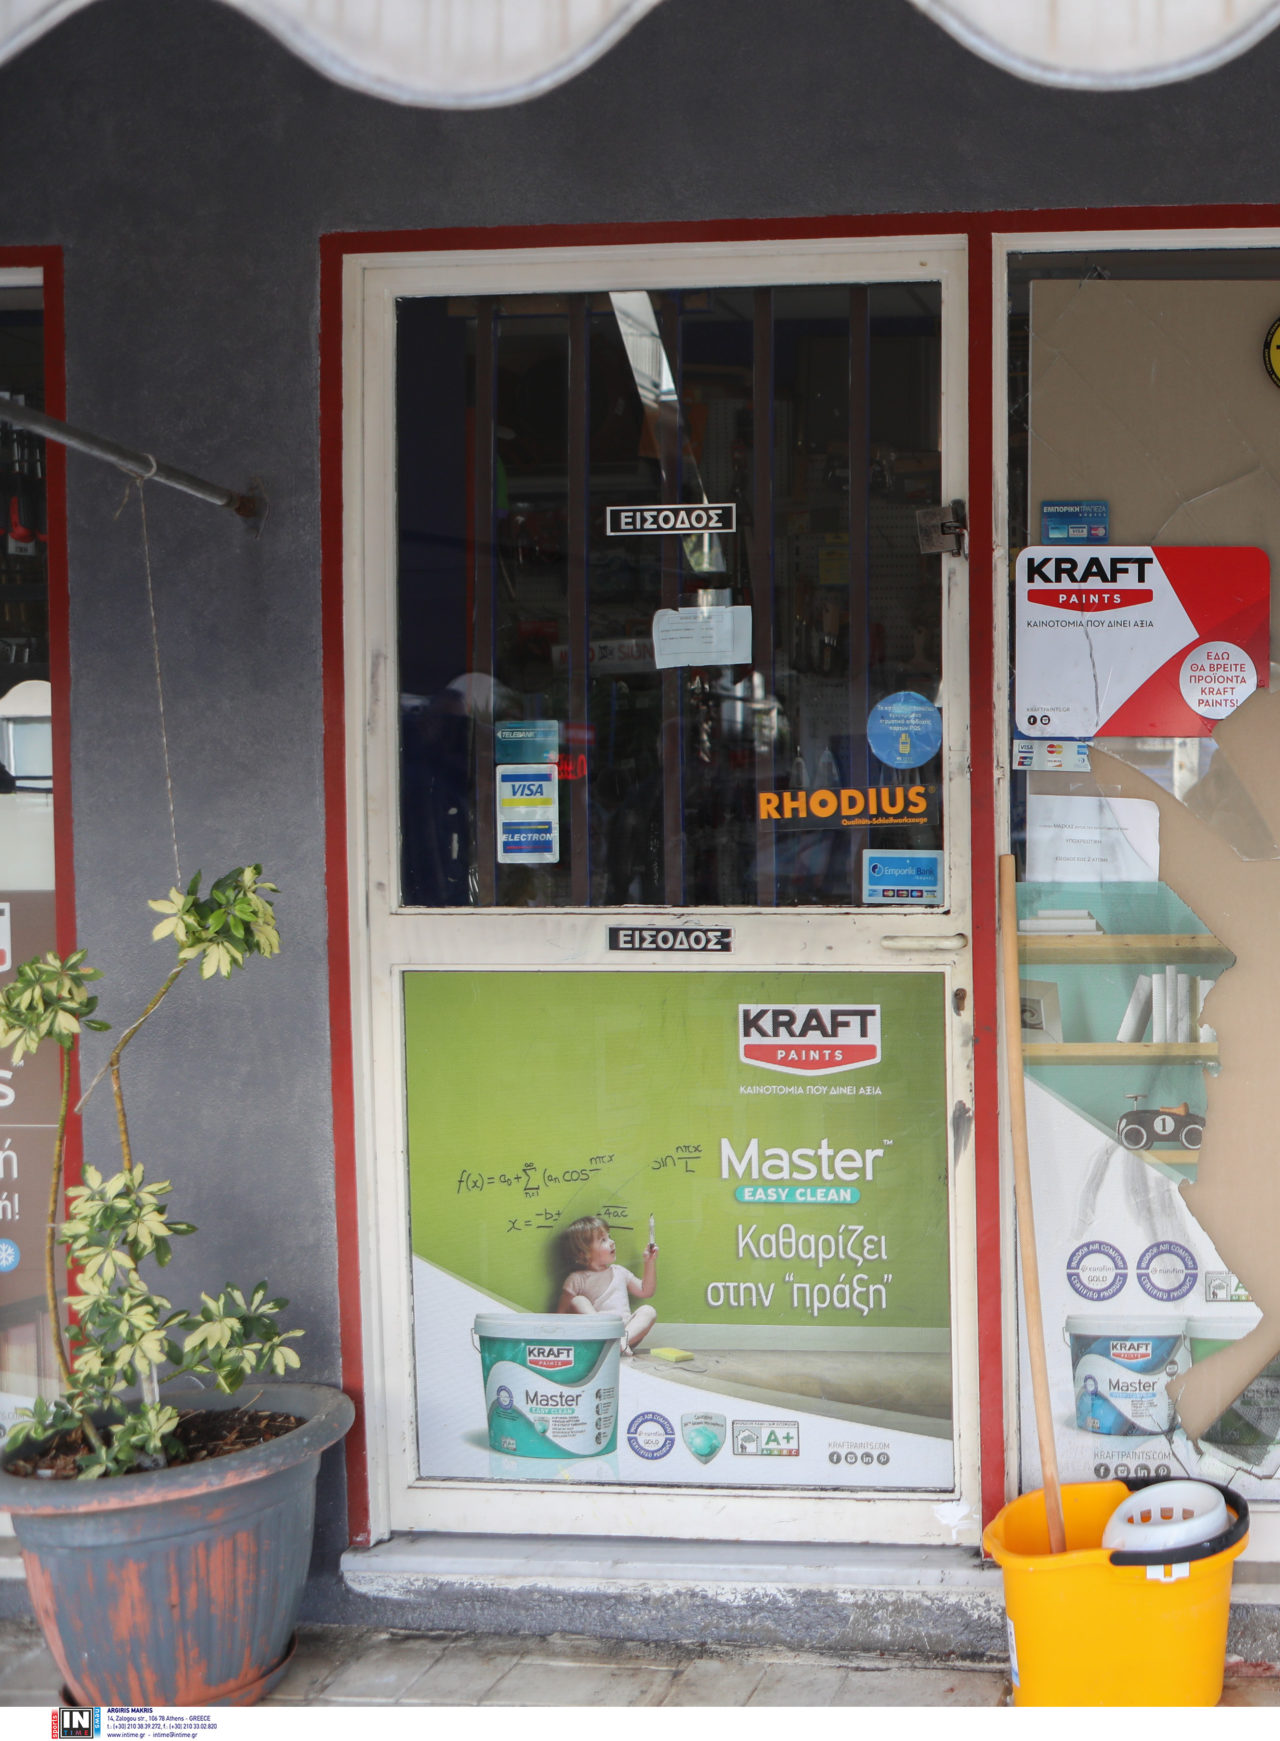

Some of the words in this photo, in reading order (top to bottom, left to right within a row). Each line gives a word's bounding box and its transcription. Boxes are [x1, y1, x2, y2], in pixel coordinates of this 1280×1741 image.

[620, 509, 723, 530] ΕΙΣΟΔΟΣ
[1027, 557, 1154, 584] KRAFT
[1059, 593, 1122, 604] PAINTS
[1027, 620, 1084, 628] ΚΑΙΝΟΤΟΜΙΑ
[1086, 620, 1106, 628] ΠΟΥ
[1107, 620, 1132, 628] ΔΙΝΕΙ
[1133, 620, 1154, 628] ΑΞΙΑ
[1206, 651, 1230, 661] ΕΔΩ
[1189, 662, 1206, 672] ΘΑ
[1208, 662, 1247, 672] ΒΡΕΙΤΕ
[1189, 673, 1247, 684] ΠΡΟΪΟΝΤΑ
[1200, 686, 1236, 696] KRAFT
[1197, 698, 1240, 708] PAINTS!
[511, 783, 545, 797] VISA
[759, 785, 928, 820] RHODIUS
[502, 833, 554, 842] ELECTRON
[619, 930, 722, 949] ΕΙΣΟΔΟΣ
[743, 1008, 877, 1038] KRAFT
[776, 1049, 844, 1061] PAINTS
[739, 1085, 805, 1095] ΚΑΙΝΟΤΟΜΙΑ
[806, 1085, 829, 1095] ΠΟΥ
[829, 1085, 857, 1096] ΔΙΝΕΙ
[859, 1085, 882, 1096] ΑΞΙΑ
[720, 1137, 885, 1181] Master
[743, 1187, 789, 1201] EASY
[795, 1187, 852, 1201] CLEAN
[737, 1223, 888, 1268] Καθαρίζει
[706, 1281, 776, 1308] στην
[528, 1347, 573, 1358] KRAFT
[1111, 1342, 1151, 1351] KRAFT
[1108, 1378, 1158, 1393] Master
[526, 1389, 582, 1407] Master
[764, 1429, 795, 1446] A+
[828, 1441, 891, 1450] KRAFTPAINTS.COM
[1093, 1450, 1171, 1460] KRAFTPAINTS.COM
